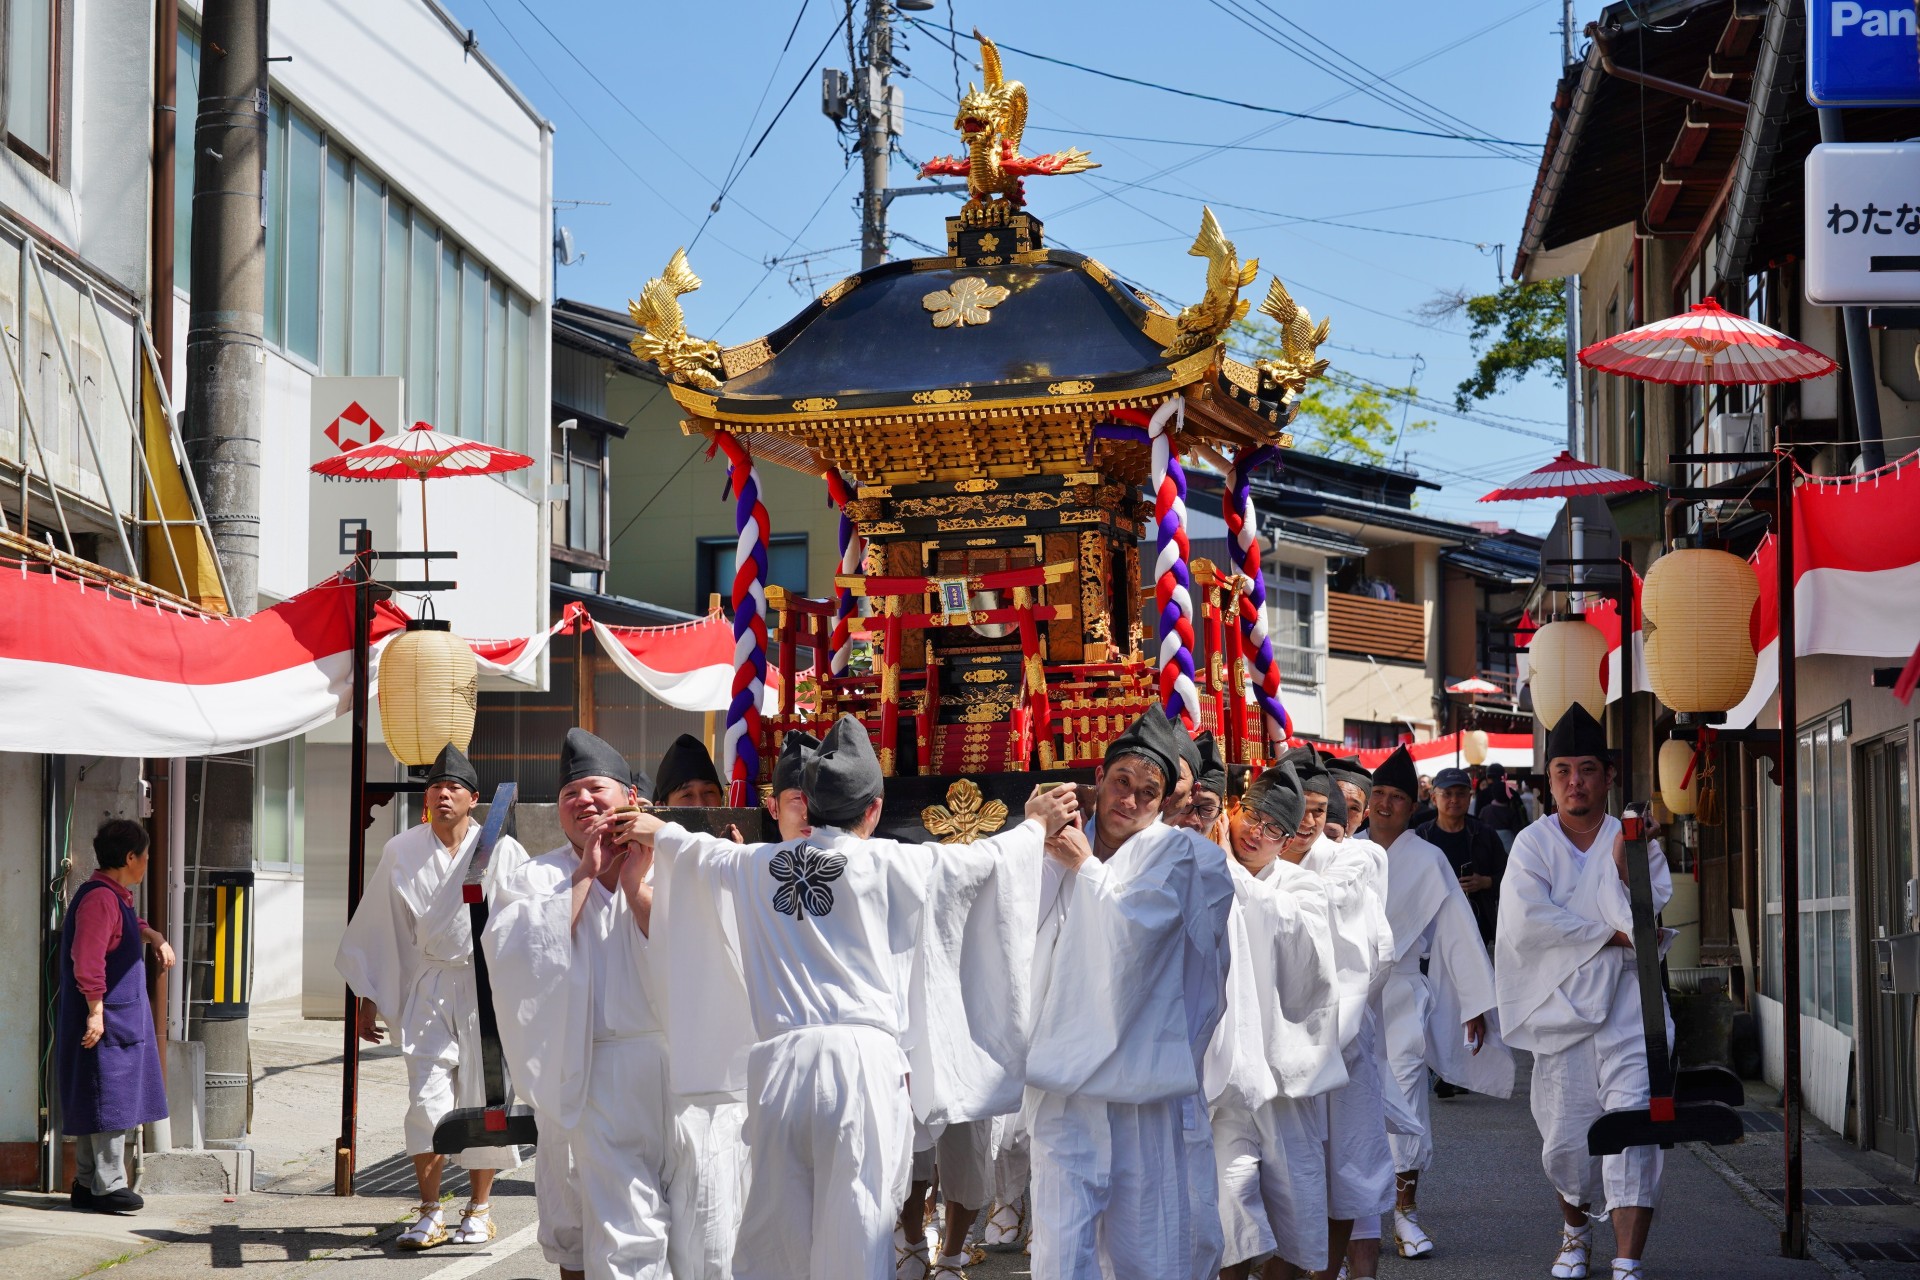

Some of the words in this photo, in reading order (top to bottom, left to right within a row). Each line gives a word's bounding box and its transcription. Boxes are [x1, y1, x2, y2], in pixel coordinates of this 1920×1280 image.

[1831, 1, 1917, 37] Pan
[1826, 202, 1920, 235] わたな
